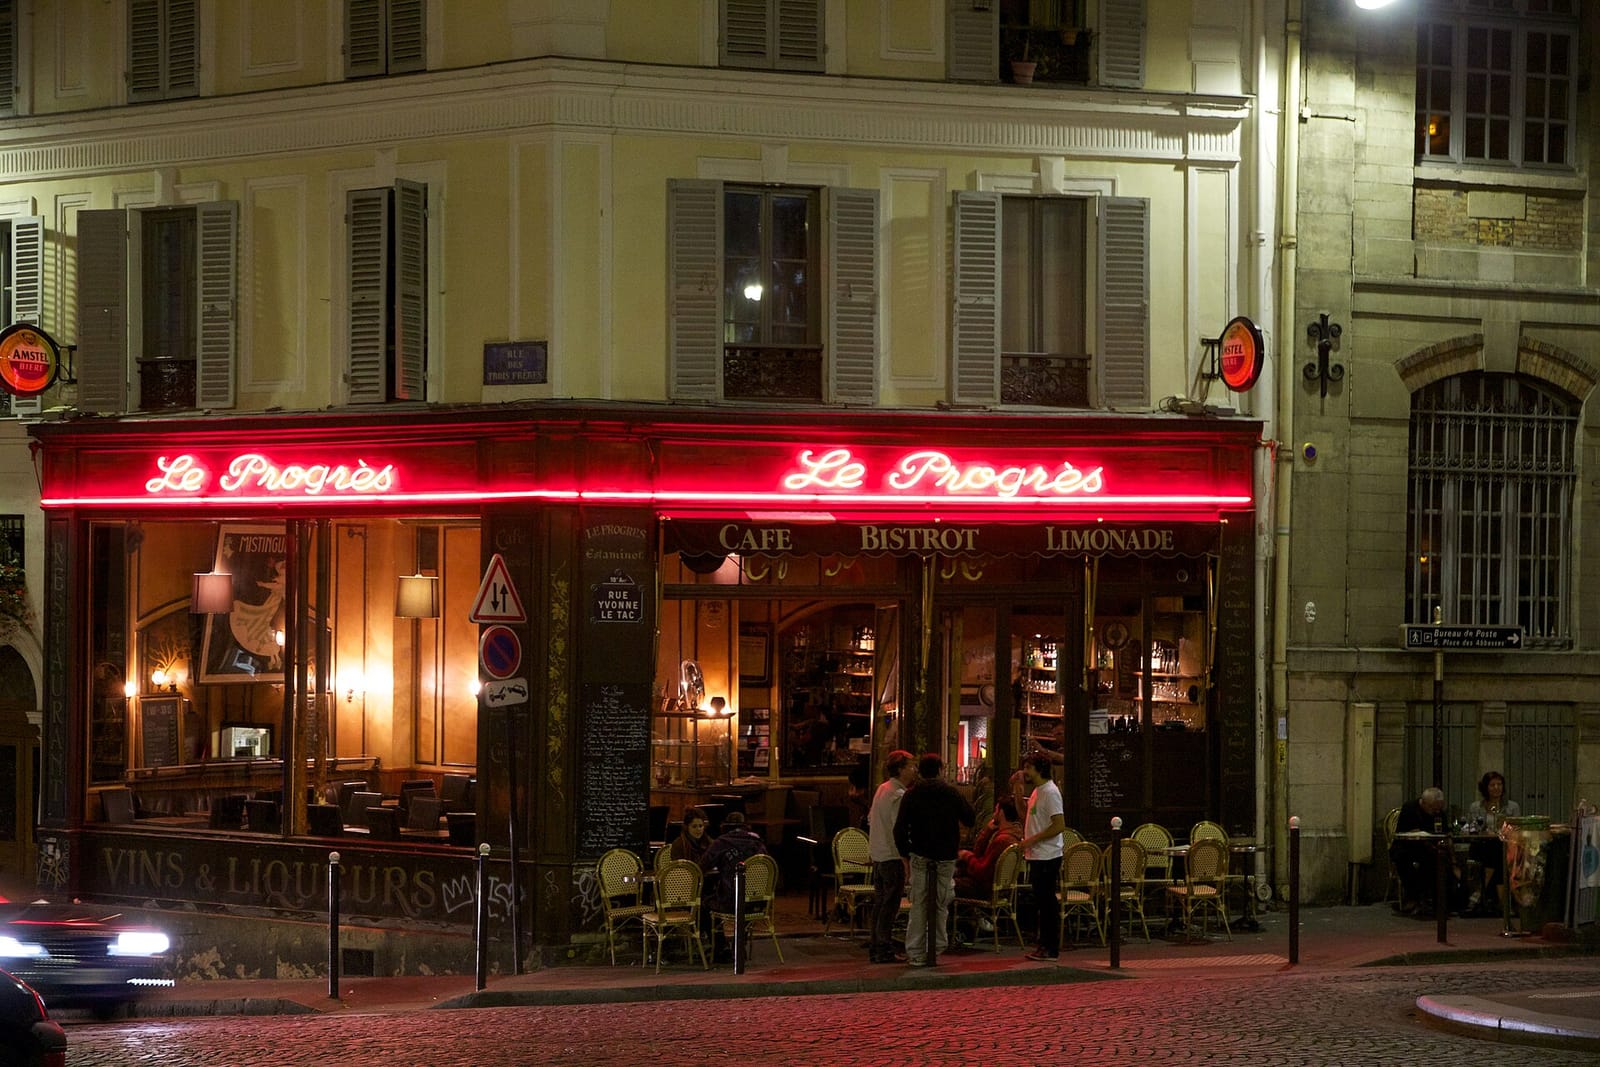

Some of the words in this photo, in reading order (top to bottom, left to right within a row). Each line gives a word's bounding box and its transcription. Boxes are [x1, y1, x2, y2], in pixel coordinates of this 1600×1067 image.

[13, 349, 48, 362] AMSTEL
[506, 350, 524, 358] RUE
[507, 361, 524, 369] DES
[145, 455, 206, 493] Le
[220, 454, 394, 495] Progrès
[784, 449, 866, 490] Le
[889, 451, 1103, 497] Progrès
[719, 525, 792, 550] CAFE
[860, 525, 979, 550] BISTROT
[1046, 526, 1175, 550] LIMONADE
[608, 591, 629, 600] RUE
[598, 600, 639, 610] YVONNE
[601, 610, 613, 619] LE
[617, 610, 635, 619] TAC
[1434, 629, 1461, 638] Bureau
[1464, 630, 1474, 638] de
[1476, 629, 1498, 638] Poste
[103, 847, 185, 889] VINS
[195, 864, 216, 890] &
